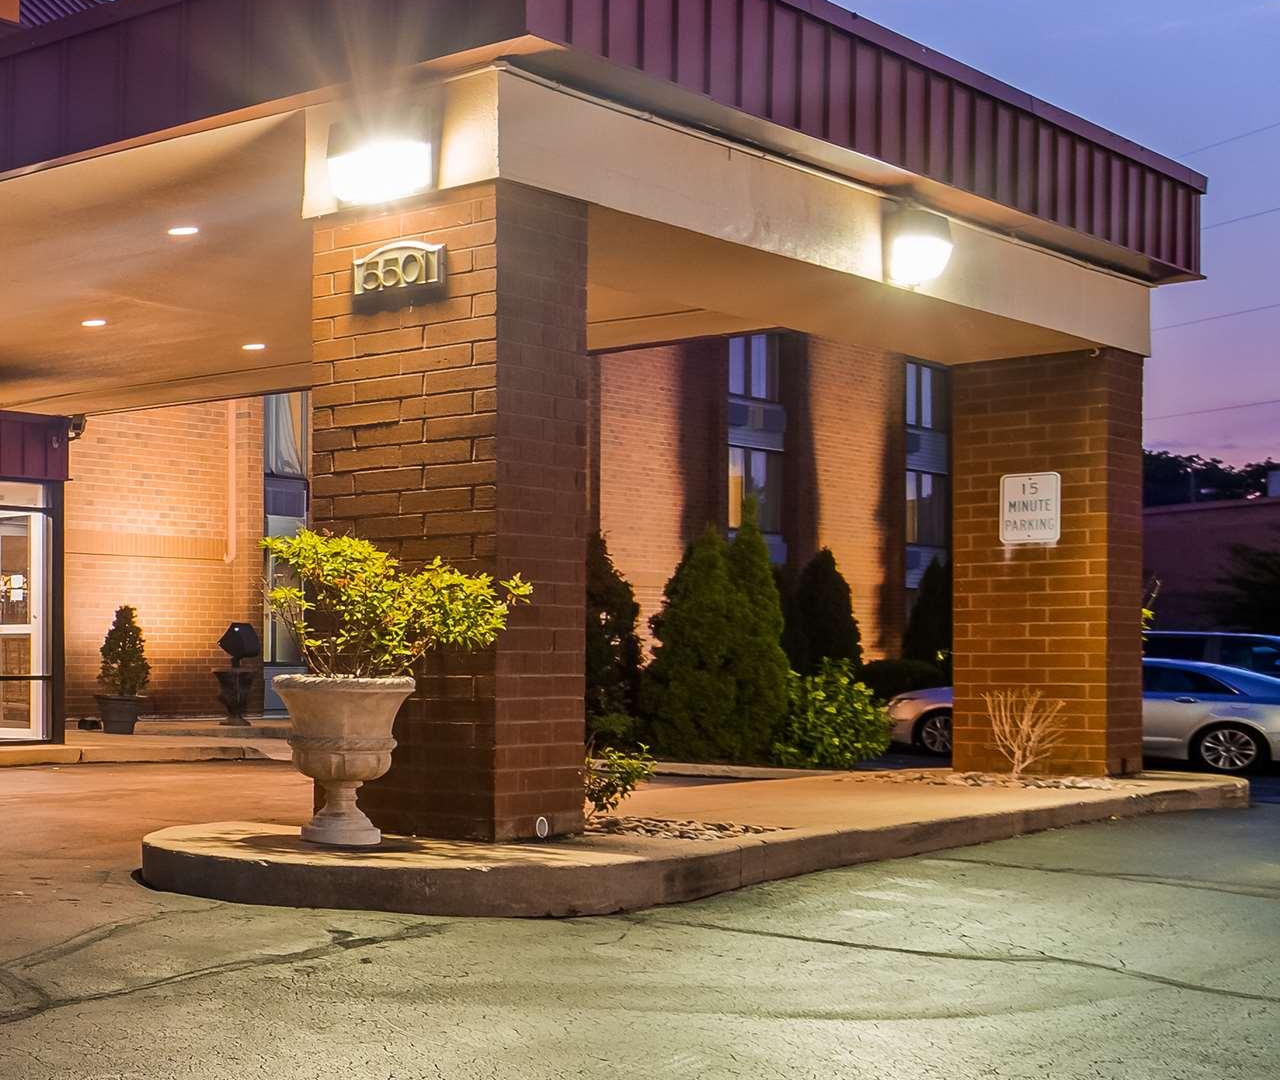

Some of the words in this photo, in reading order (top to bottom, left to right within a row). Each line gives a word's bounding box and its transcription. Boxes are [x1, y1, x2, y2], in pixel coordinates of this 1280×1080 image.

[1022, 482, 1039, 496] 15
[1008, 498, 1053, 513] MINUTE
[1005, 518, 1055, 532] PARKING
